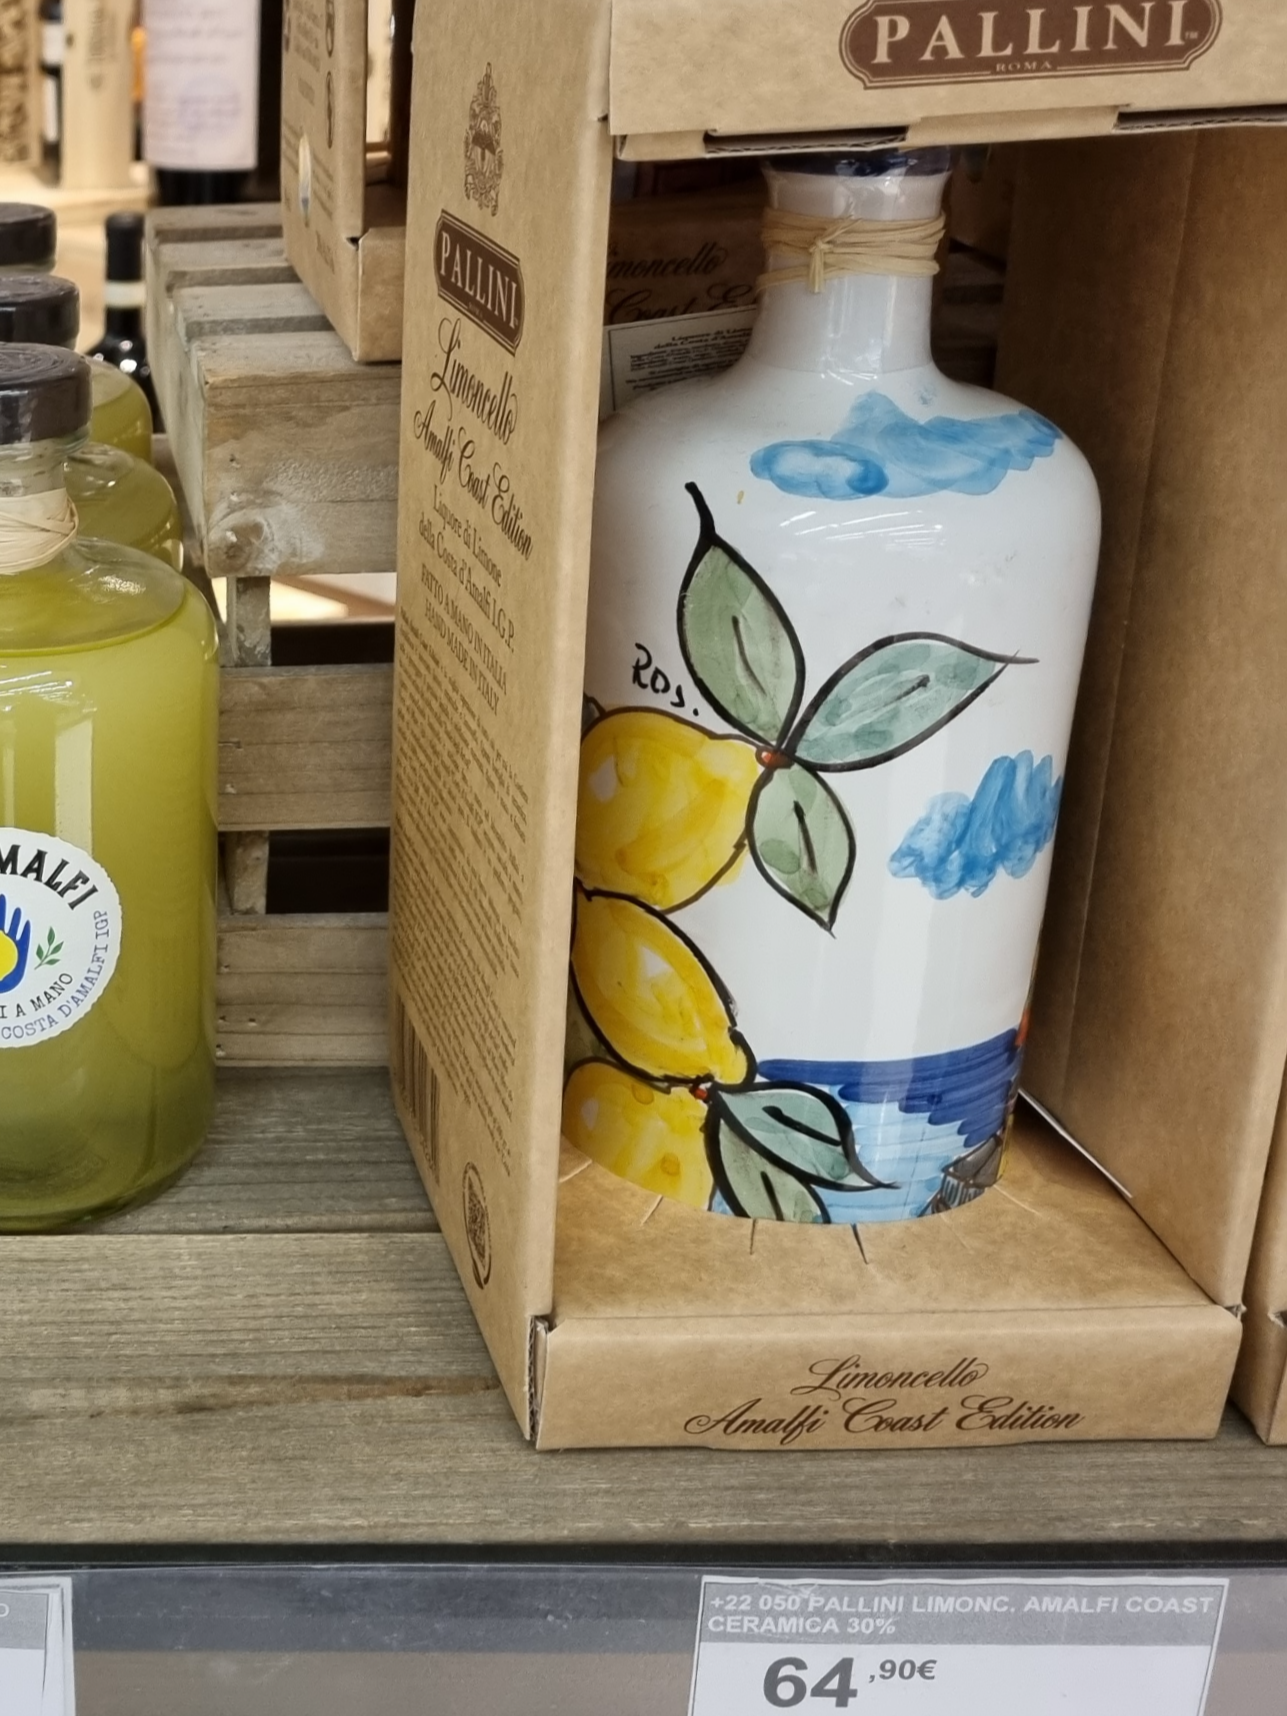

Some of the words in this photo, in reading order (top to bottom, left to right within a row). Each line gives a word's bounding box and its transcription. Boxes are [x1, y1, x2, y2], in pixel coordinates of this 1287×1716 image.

[870, 0, 1188, 65] PALLINI
[995, 60, 1054, 73] ROMA
[439, 231, 518, 330] PALLINI
[430, 317, 518, 446] Limoncello
[413, 400, 456, 485] Amalfi
[457, 426, 491, 510] Coast
[491, 461, 533, 561] Edition
[419, 511, 436, 551] della
[436, 531, 458, 578] Costa
[433, 484, 462, 539] Liquore
[463, 519, 472, 550] di
[472, 527, 502, 588] Limone
[421, 562, 444, 606] FATTO
[450, 599, 474, 645] MANO
[482, 642, 507, 696] ITALIA
[446, 626, 469, 672] MADE
[478, 669, 500, 717] ITALY
[1, 1013, 59, 1040] COSTA
[57, 943, 109, 1019] D'AMALFI
[93, 909, 110, 942] IGP
[15, 1002, 27, 1018] A
[30, 971, 74, 1013] MANO
[789, 1353, 990, 1401] Limoncello
[683, 1396, 830, 1446] Amalfi
[841, 1396, 950, 1434] Coast
[954, 1394, 1086, 1432] Edition
[707, 1615, 840, 1634] CERAMICA
[846, 1616, 896, 1635] 30%
[710, 1594, 752, 1611] +22
[758, 1594, 801, 1612] 050
[807, 1595, 904, 1613] PALLINI
[911, 1595, 1015, 1614] LIMONC.
[1022, 1595, 1120, 1614] AMALFI
[1125, 1595, 1215, 1614] COAST
[762, 1656, 859, 1709] 64
